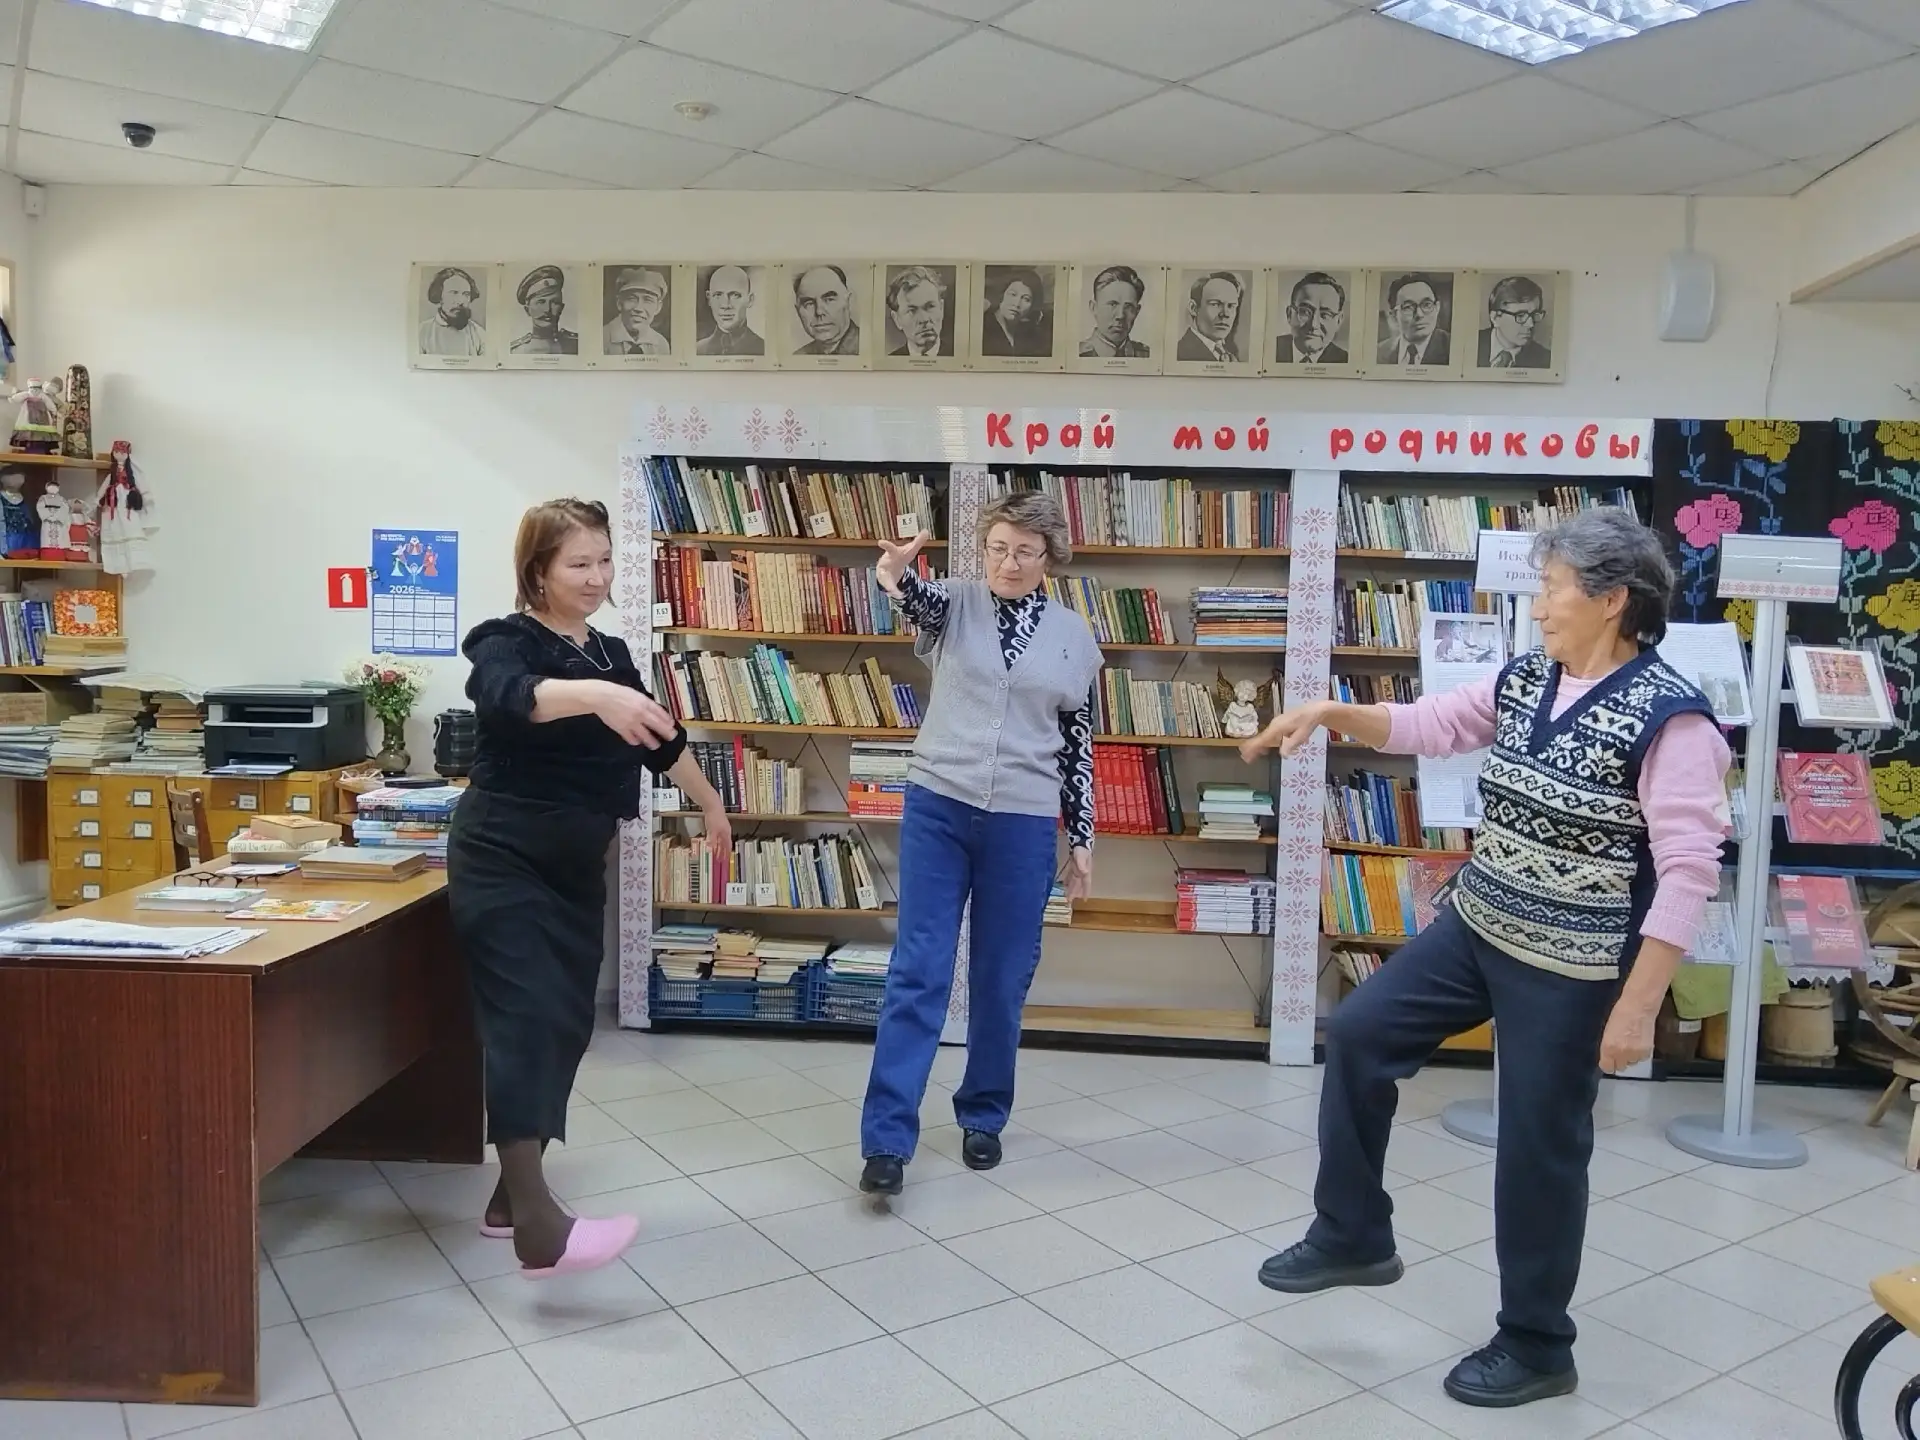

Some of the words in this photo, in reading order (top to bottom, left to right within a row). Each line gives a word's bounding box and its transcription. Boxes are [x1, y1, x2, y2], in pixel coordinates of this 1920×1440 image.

[987, 413, 1113, 452] Край
[1173, 418, 1268, 450] мой
[1330, 425, 1638, 458] родниковы
[389, 585, 415, 594] 2026
